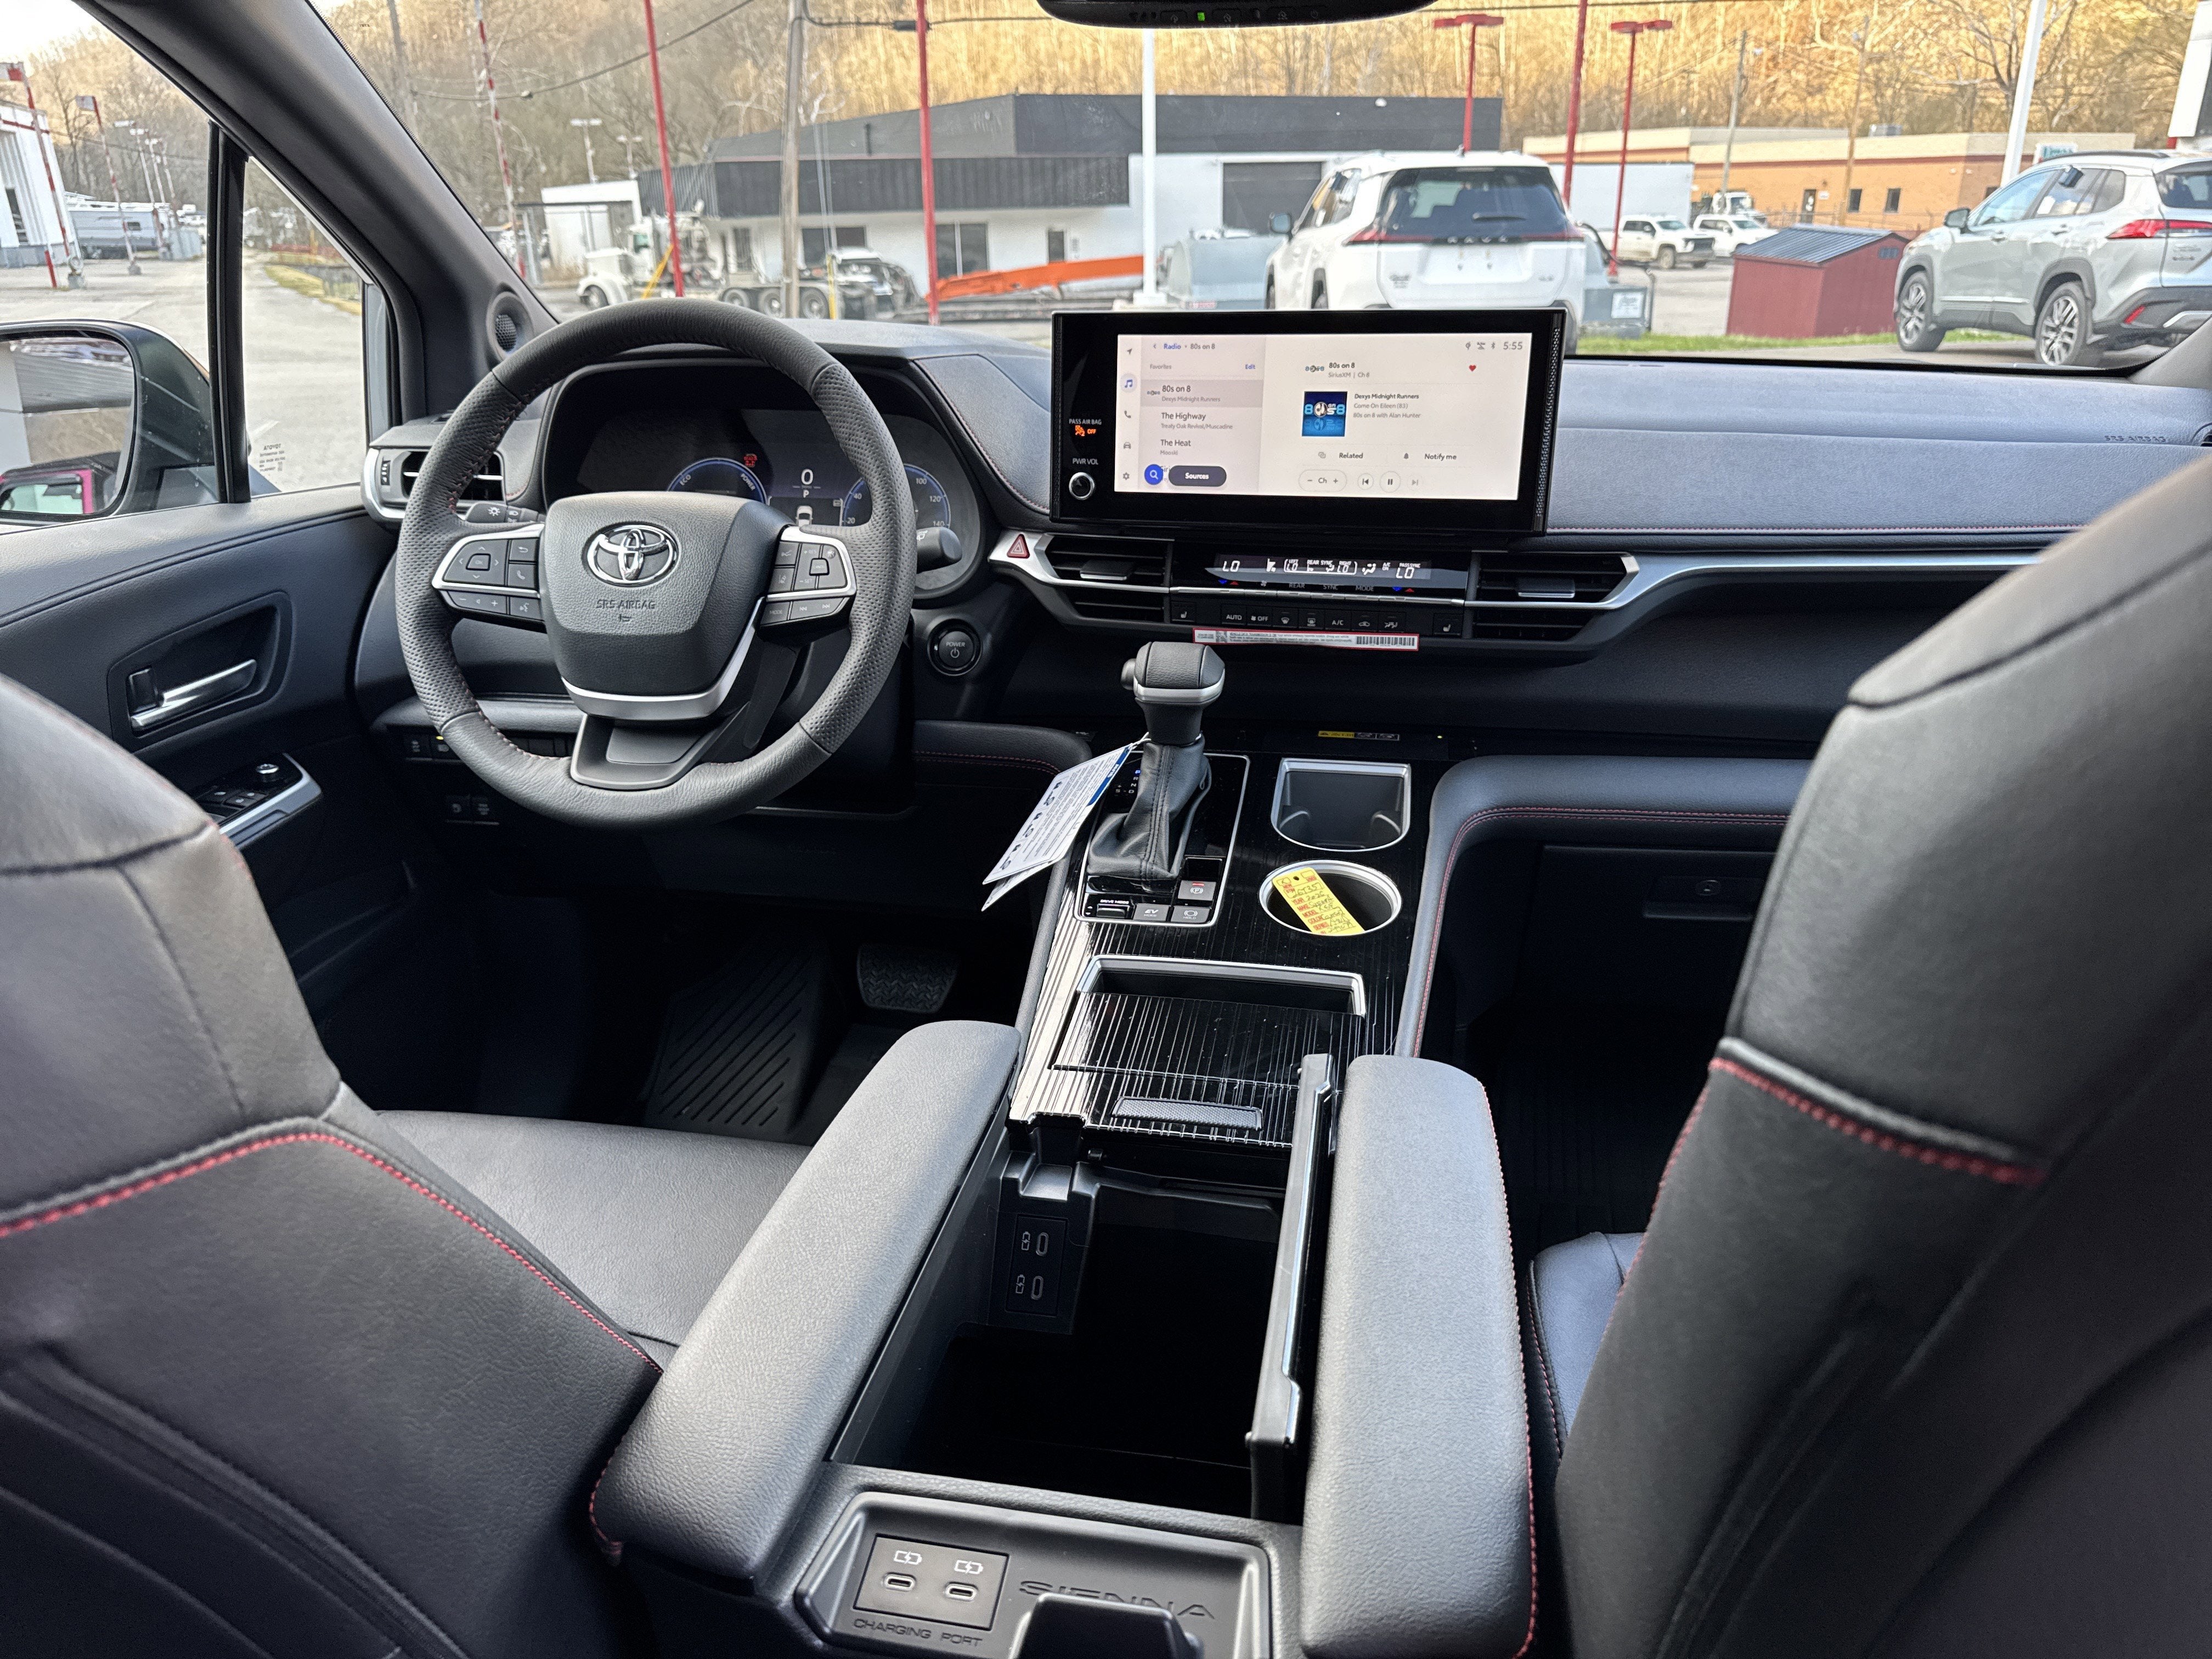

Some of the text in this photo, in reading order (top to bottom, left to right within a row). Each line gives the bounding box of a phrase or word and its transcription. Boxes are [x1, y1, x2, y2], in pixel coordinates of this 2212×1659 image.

[1503, 341, 1523, 350] 5:55
[1175, 412, 1206, 421] Highway
[1424, 453, 1444, 461] Notify
[679, 474, 691, 486] ECO
[741, 473, 756, 491] POWER
[801, 469, 814, 485] 0
[803, 489, 810, 498] P
[596, 599, 656, 610] SRS AIRBAG
[854, 1618, 983, 1647] CHARGING PORT
